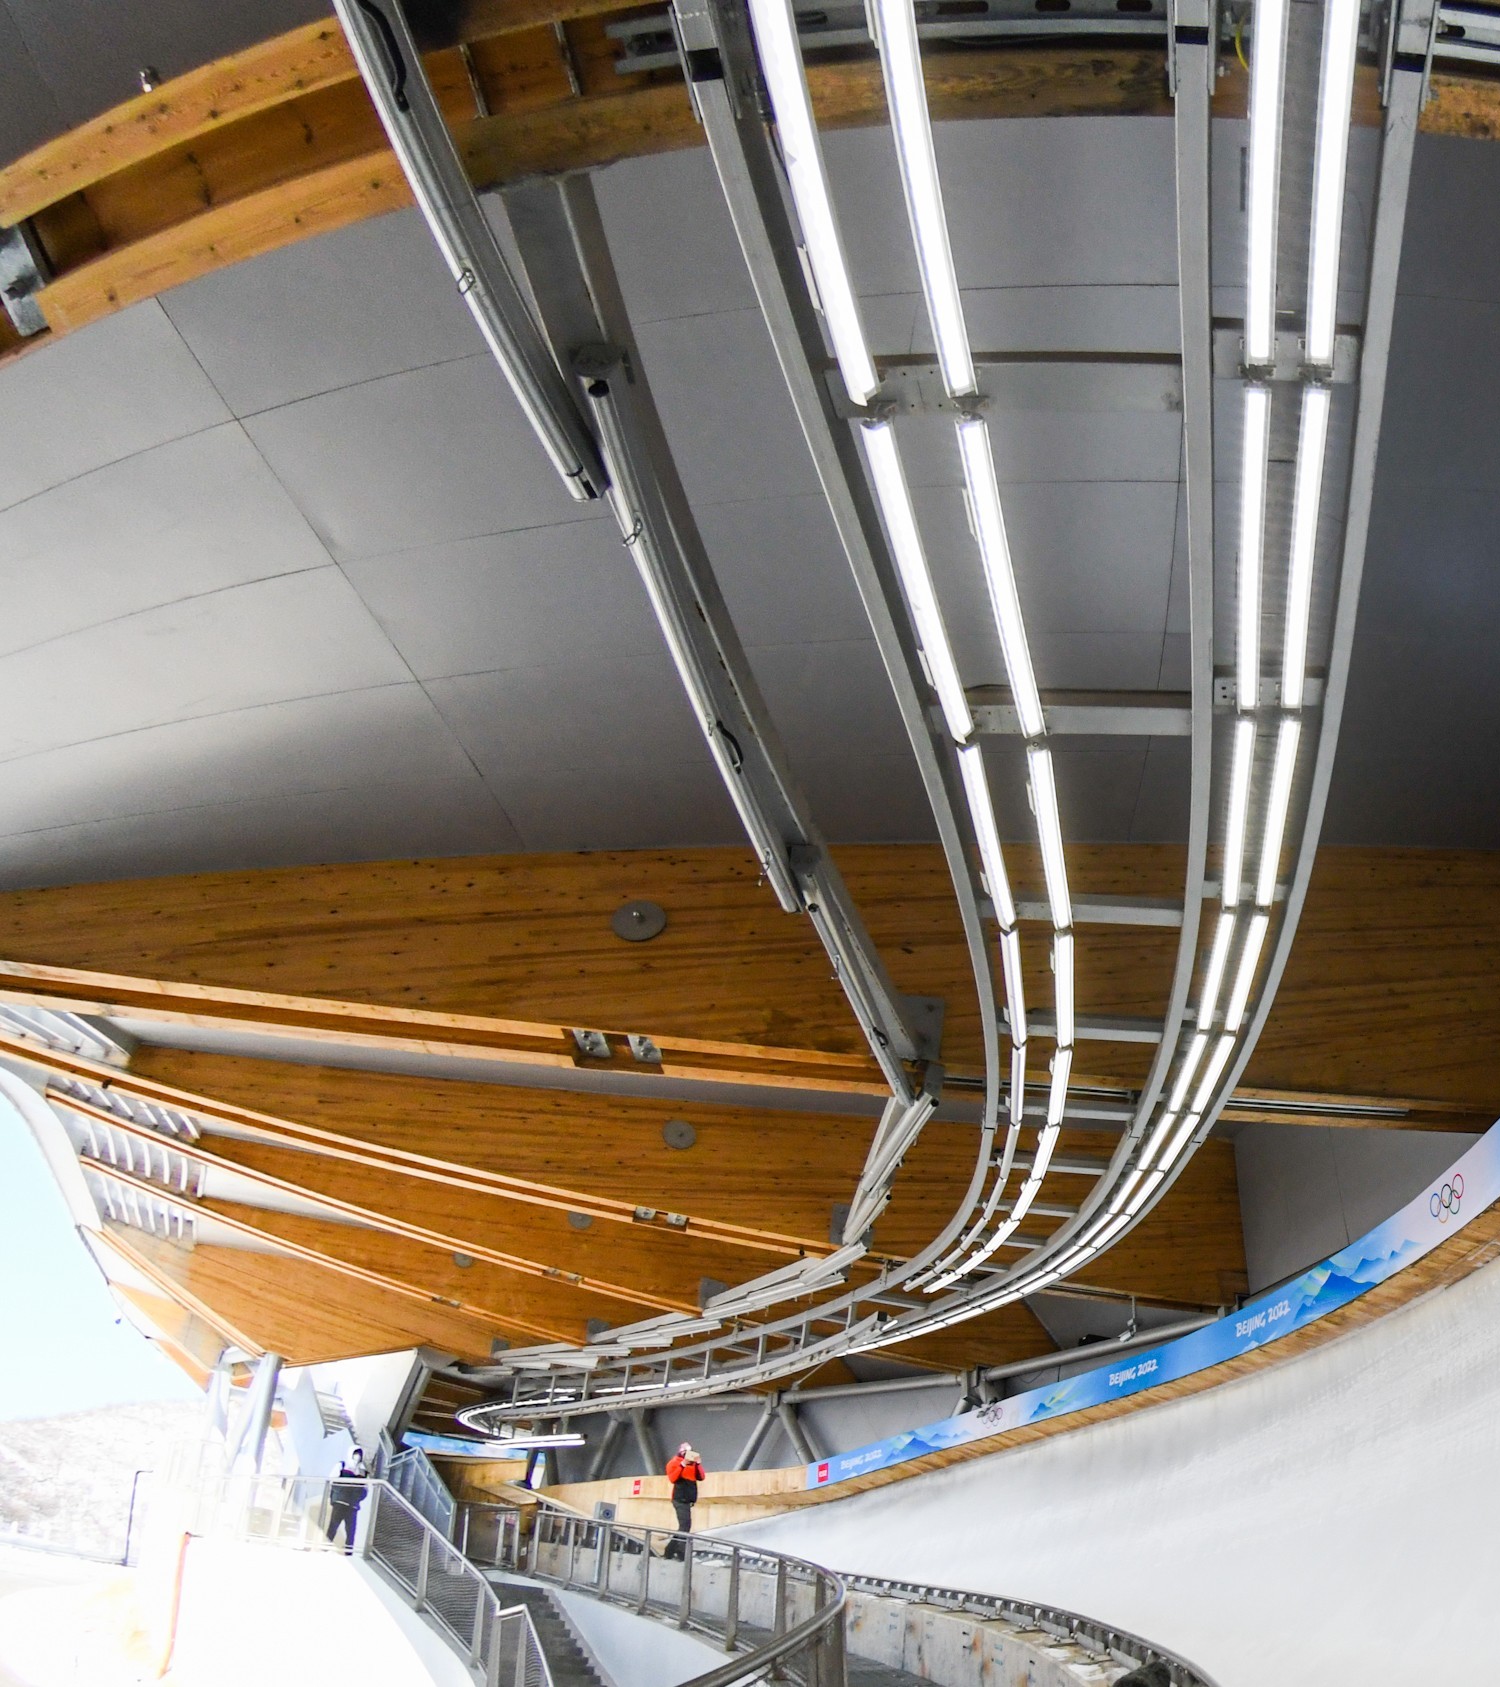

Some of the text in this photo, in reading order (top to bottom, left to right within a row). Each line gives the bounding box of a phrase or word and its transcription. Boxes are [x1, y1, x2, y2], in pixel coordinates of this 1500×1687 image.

[1235, 1300, 1291, 1337] BEIJING 2022
[1109, 1359, 1158, 1387] BEIJING 2022
